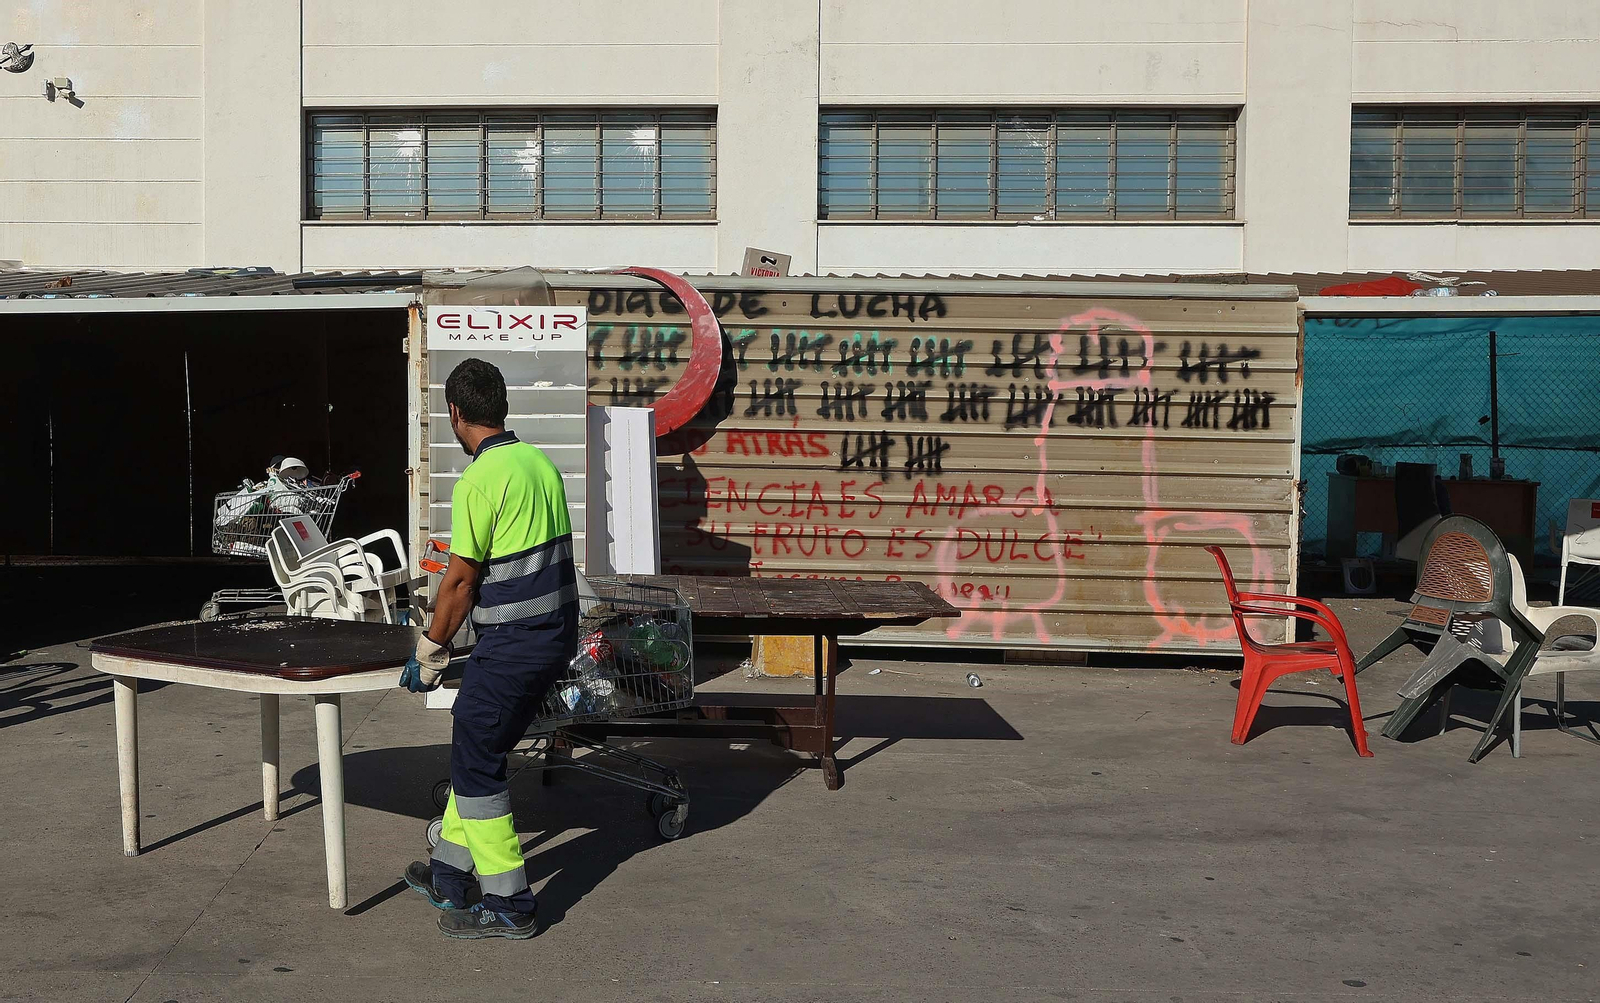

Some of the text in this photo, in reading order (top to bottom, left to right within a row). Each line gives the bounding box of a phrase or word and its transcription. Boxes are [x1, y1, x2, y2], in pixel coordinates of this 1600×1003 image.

[750, 267, 781, 278] VICTORIA
[713, 289, 769, 319] DE
[809, 293, 947, 322] LUCHA
[437, 314, 578, 330] ELIXIR
[684, 519, 731, 551] SU
[748, 521, 867, 557] FRUTO
[885, 527, 933, 559] ES
